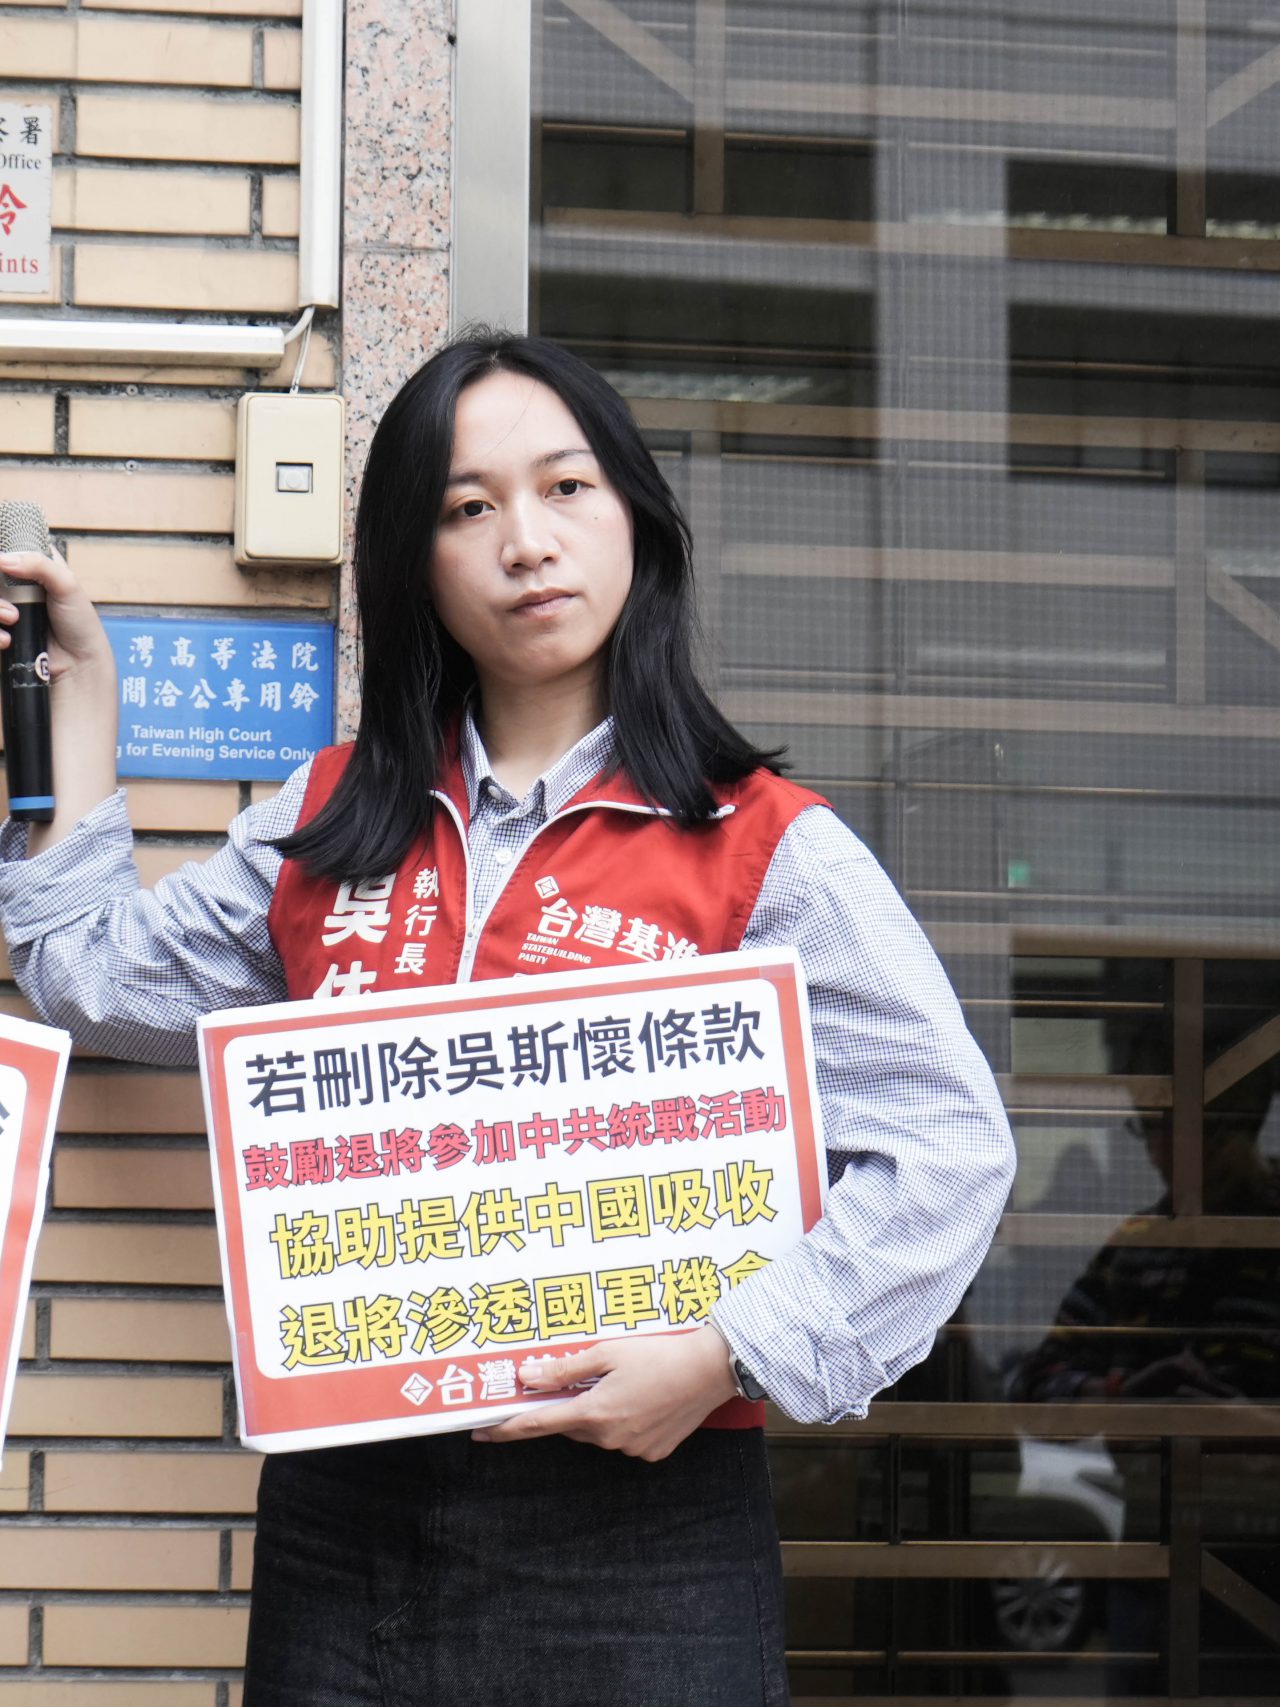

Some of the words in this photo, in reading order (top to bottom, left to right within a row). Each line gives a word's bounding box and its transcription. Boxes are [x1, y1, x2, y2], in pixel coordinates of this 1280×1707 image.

[129, 635, 319, 671] 灣高等法院
[126, 743, 148, 756] for
[152, 744, 214, 761] Evening
[219, 745, 276, 760] Service
[131, 725, 184, 740] Taiwan
[189, 727, 224, 743] High
[229, 728, 272, 741] Court
[394, 866, 439, 975] 執行長
[526, 932, 560, 945] TAIWAN
[518, 952, 548, 965] PARTY
[521, 943, 592, 964] STATEBUILDING
[245, 1001, 765, 1117] 若刪除吳斯懷條款
[242, 1087, 787, 1191] 鼓勵退將參加中共統戰活動
[270, 1160, 776, 1279] 協助提供中國吸收
[436, 1350, 601, 1405] 台灣
